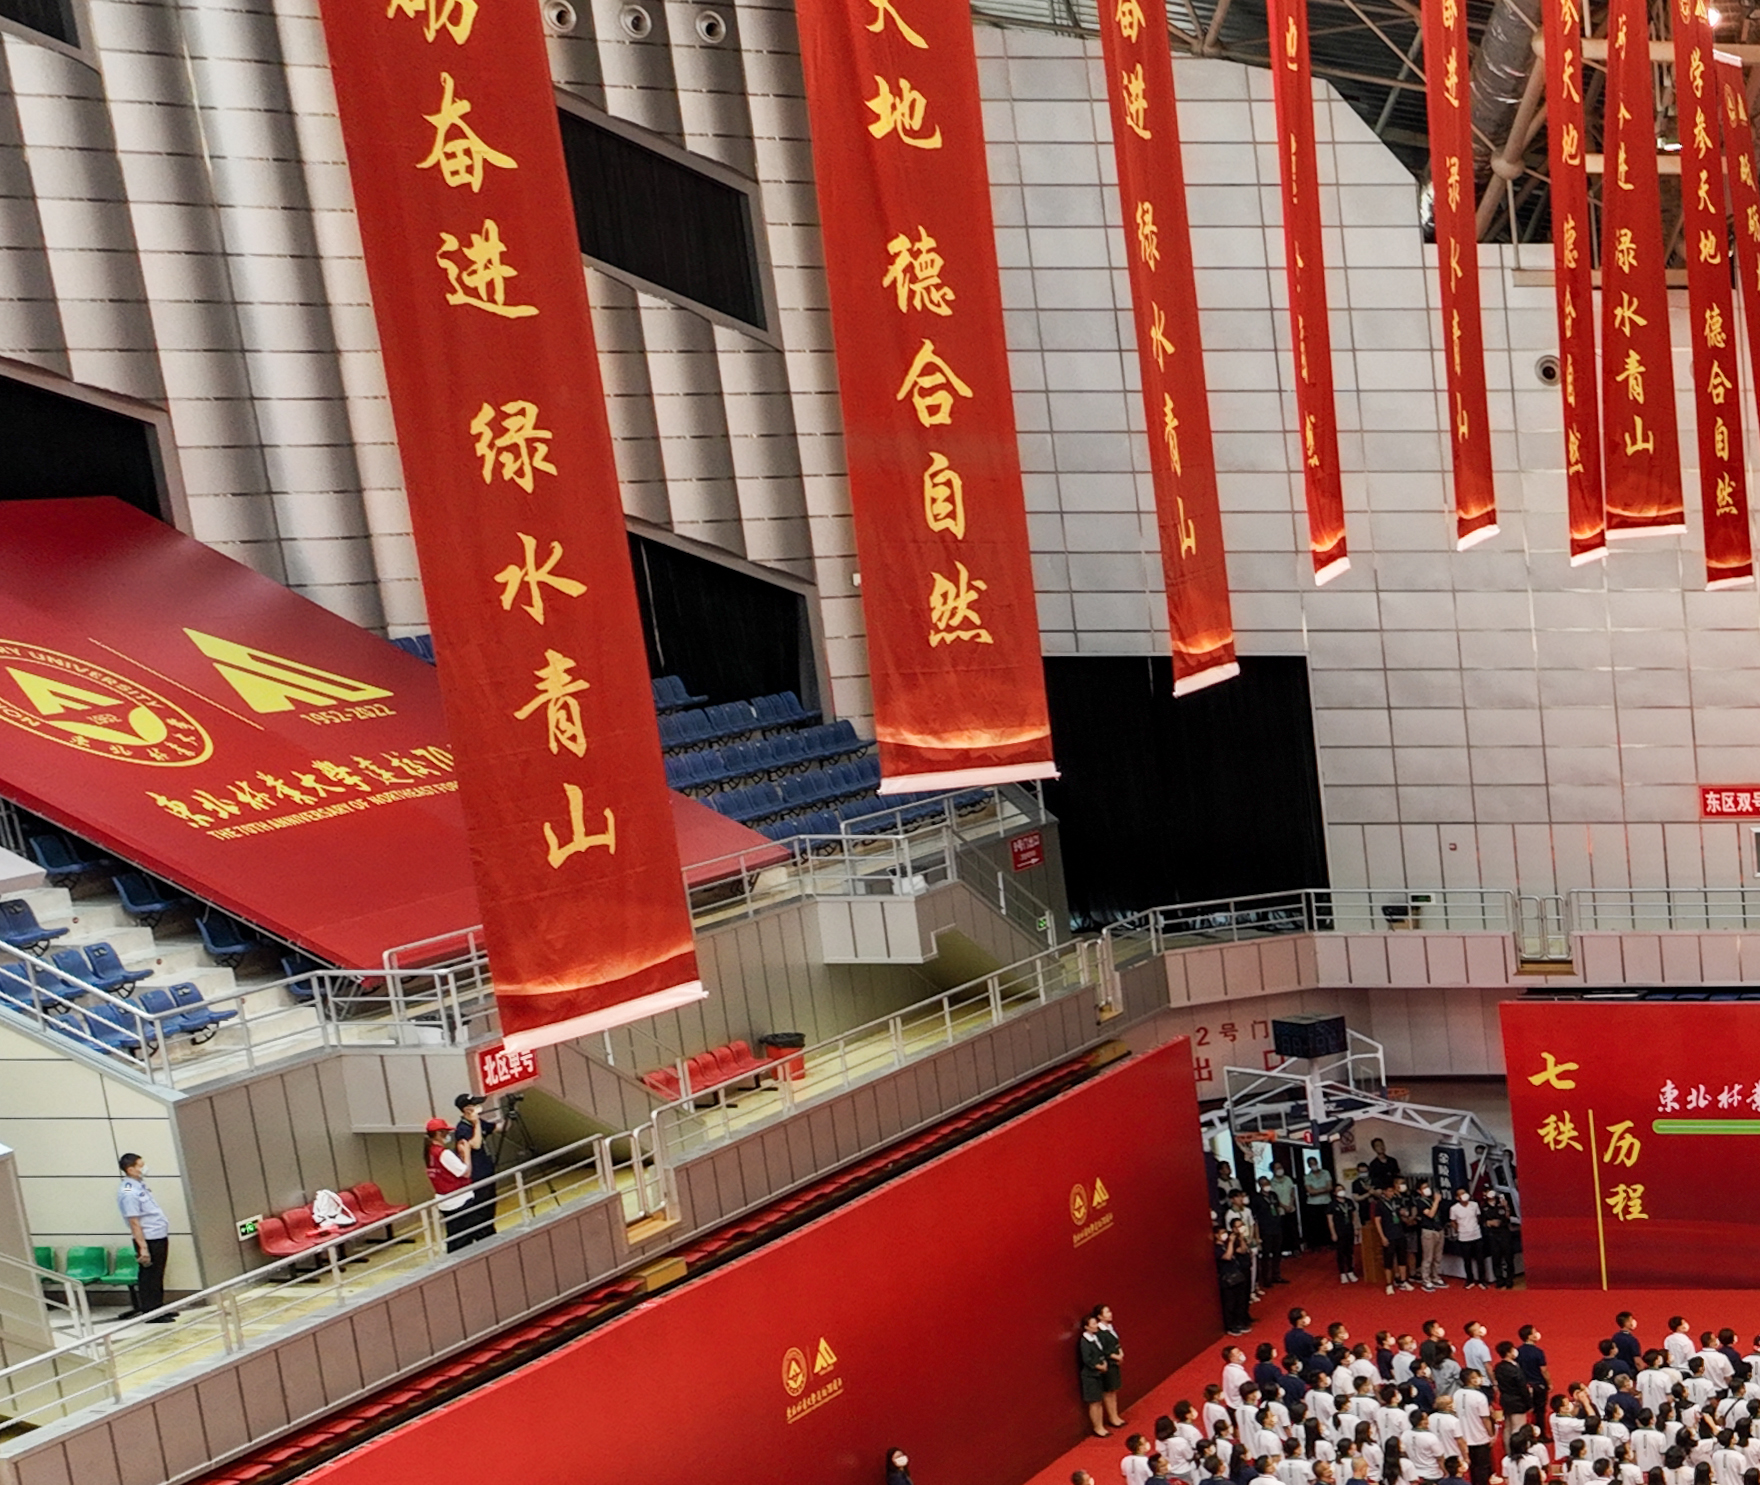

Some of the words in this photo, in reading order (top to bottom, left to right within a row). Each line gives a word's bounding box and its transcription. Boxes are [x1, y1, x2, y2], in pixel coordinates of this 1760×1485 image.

[1136, 202, 1195, 558] 绿水青山
[1614, 229, 1655, 455] 绿水青山
[1705, 303, 1738, 515] 德合自然
[883, 226, 993, 647] 德合自然
[27, 650, 164, 708] UNIVERSITY
[469, 400, 617, 870] 绿水青山
[300, 702, 397, 727] 1952-2022
[1195, 1020, 1269, 1046] 2号门
[1528, 1052, 1583, 1151] 七秩
[1603, 1121, 1649, 1221] 历程
